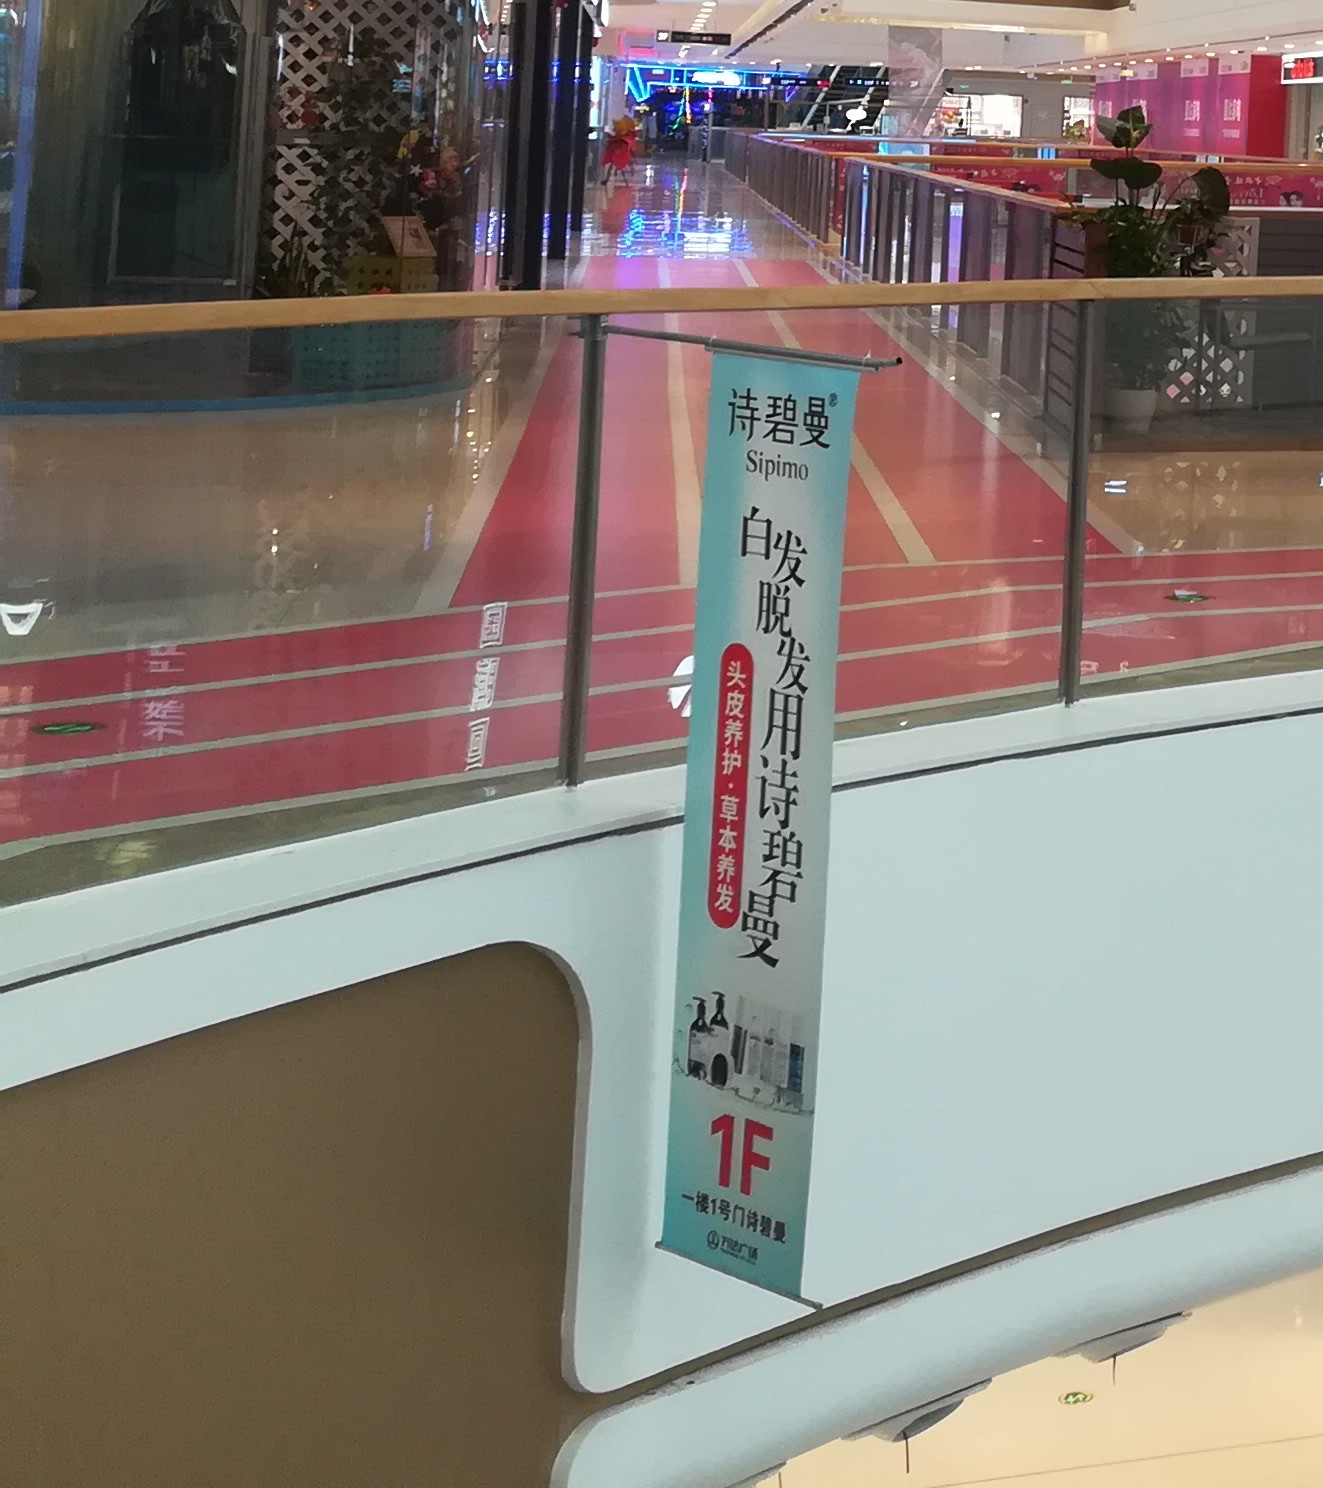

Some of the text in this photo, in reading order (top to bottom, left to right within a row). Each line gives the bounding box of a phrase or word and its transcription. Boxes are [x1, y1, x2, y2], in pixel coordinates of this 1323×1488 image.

[728, 388, 831, 449] 诗碧曼
[745, 449, 809, 481] Sipimo
[736, 506, 811, 968] 白发脱发用诗碧曼
[710, 1114, 774, 1196] 1F
